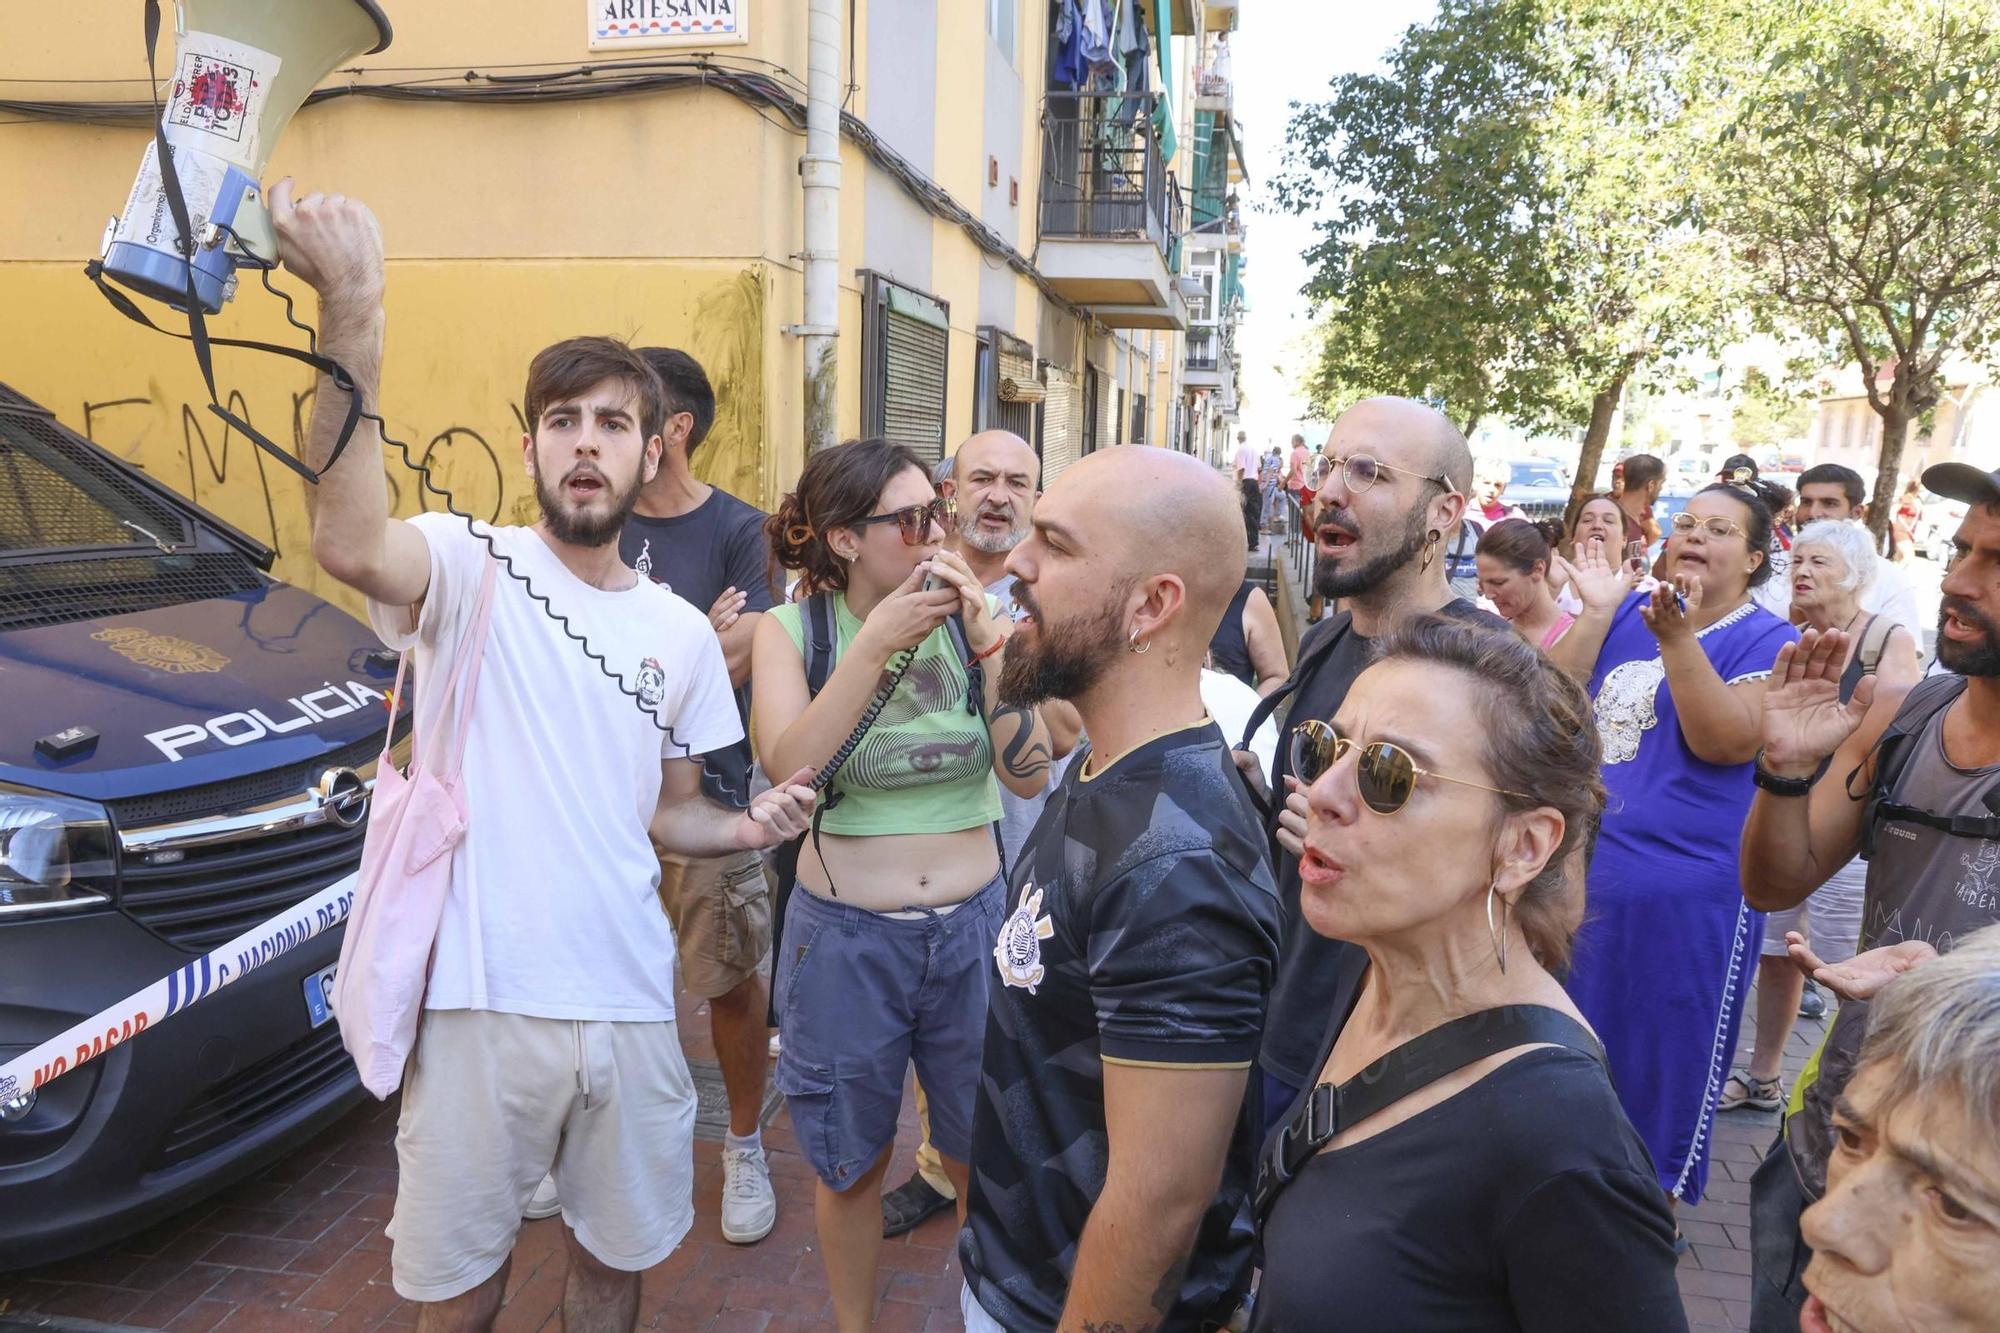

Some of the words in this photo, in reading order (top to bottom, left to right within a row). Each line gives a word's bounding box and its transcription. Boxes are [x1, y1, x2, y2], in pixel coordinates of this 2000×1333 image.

[211, 66, 239, 130] TODAS
[144, 681, 386, 762] POLICÍA
[316, 902, 336, 932] DE
[314, 1003, 322, 1016] E
